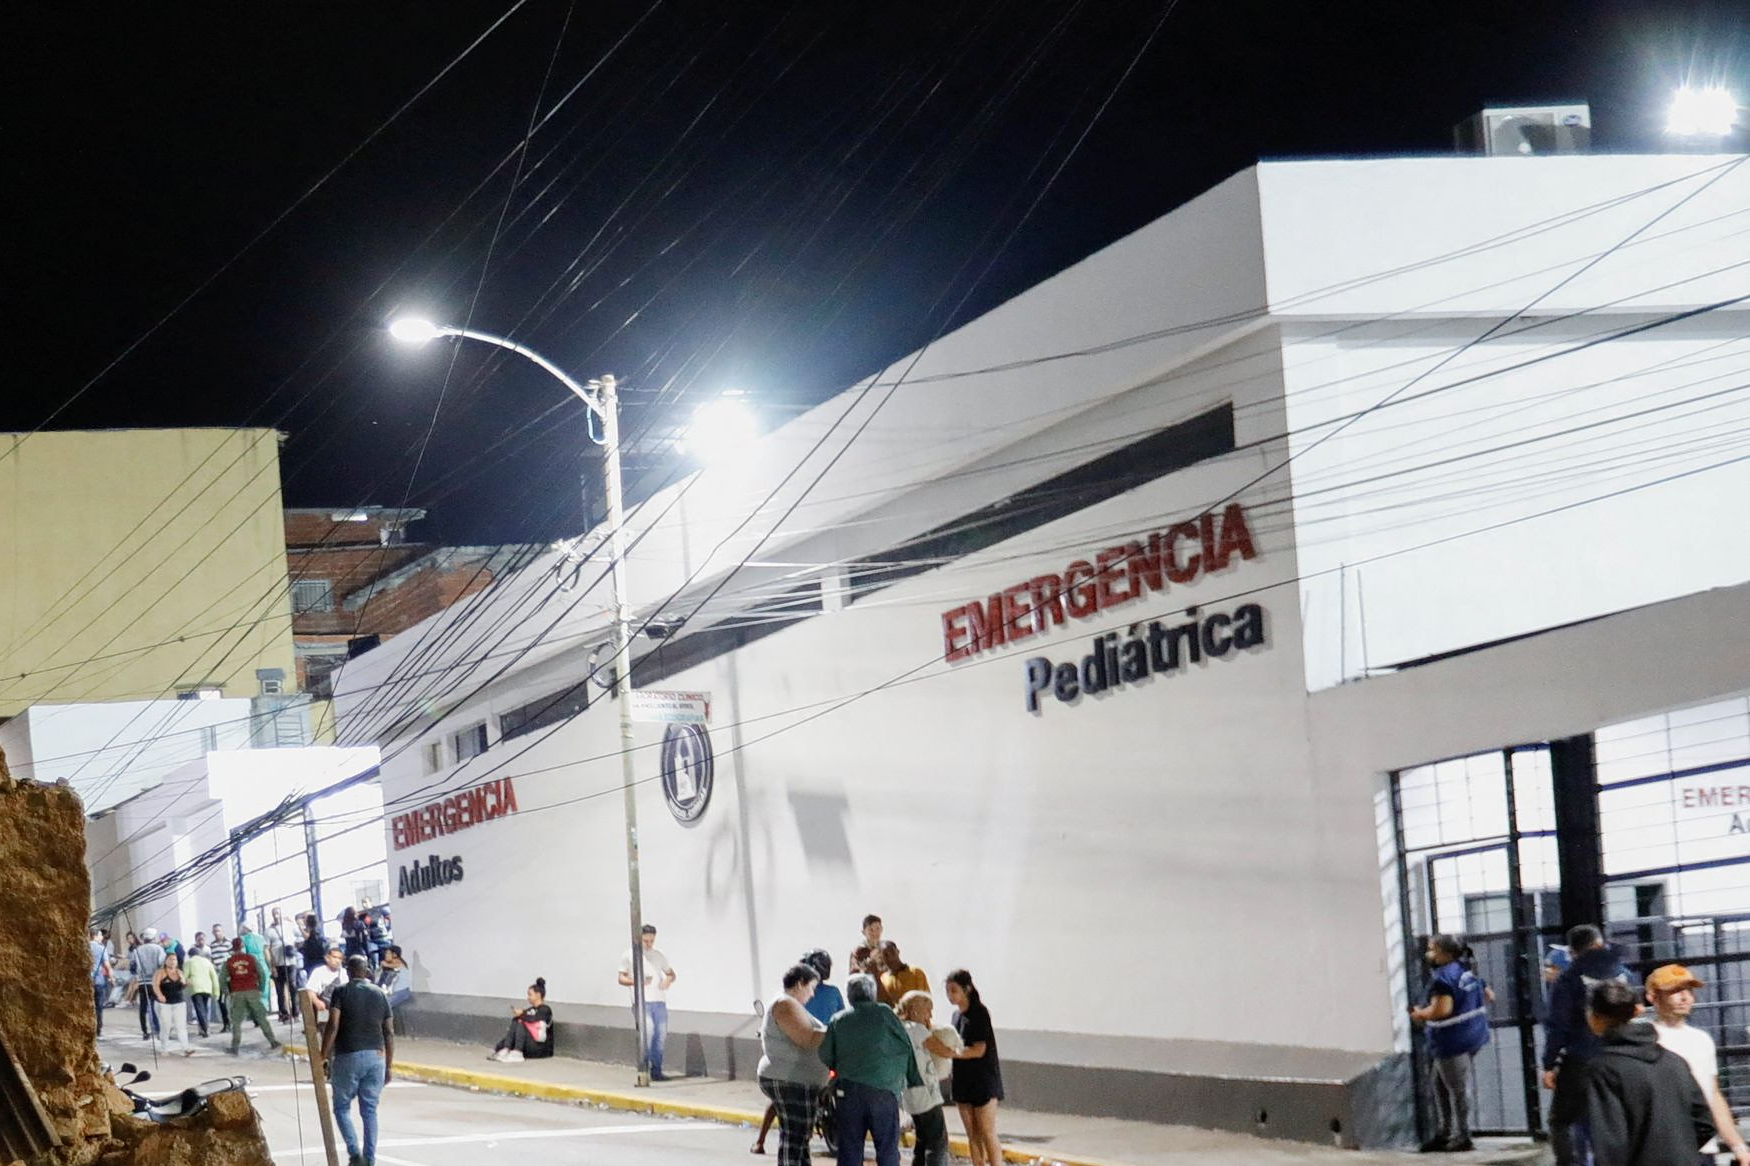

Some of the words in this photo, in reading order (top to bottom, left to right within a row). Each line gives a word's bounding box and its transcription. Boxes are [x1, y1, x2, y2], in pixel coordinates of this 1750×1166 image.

[941, 502, 1257, 662] EMERGENCIA
[1025, 602, 1264, 712] Pediátrica
[392, 776, 517, 851] EMERGENCIA
[398, 854, 464, 898] Adultos
